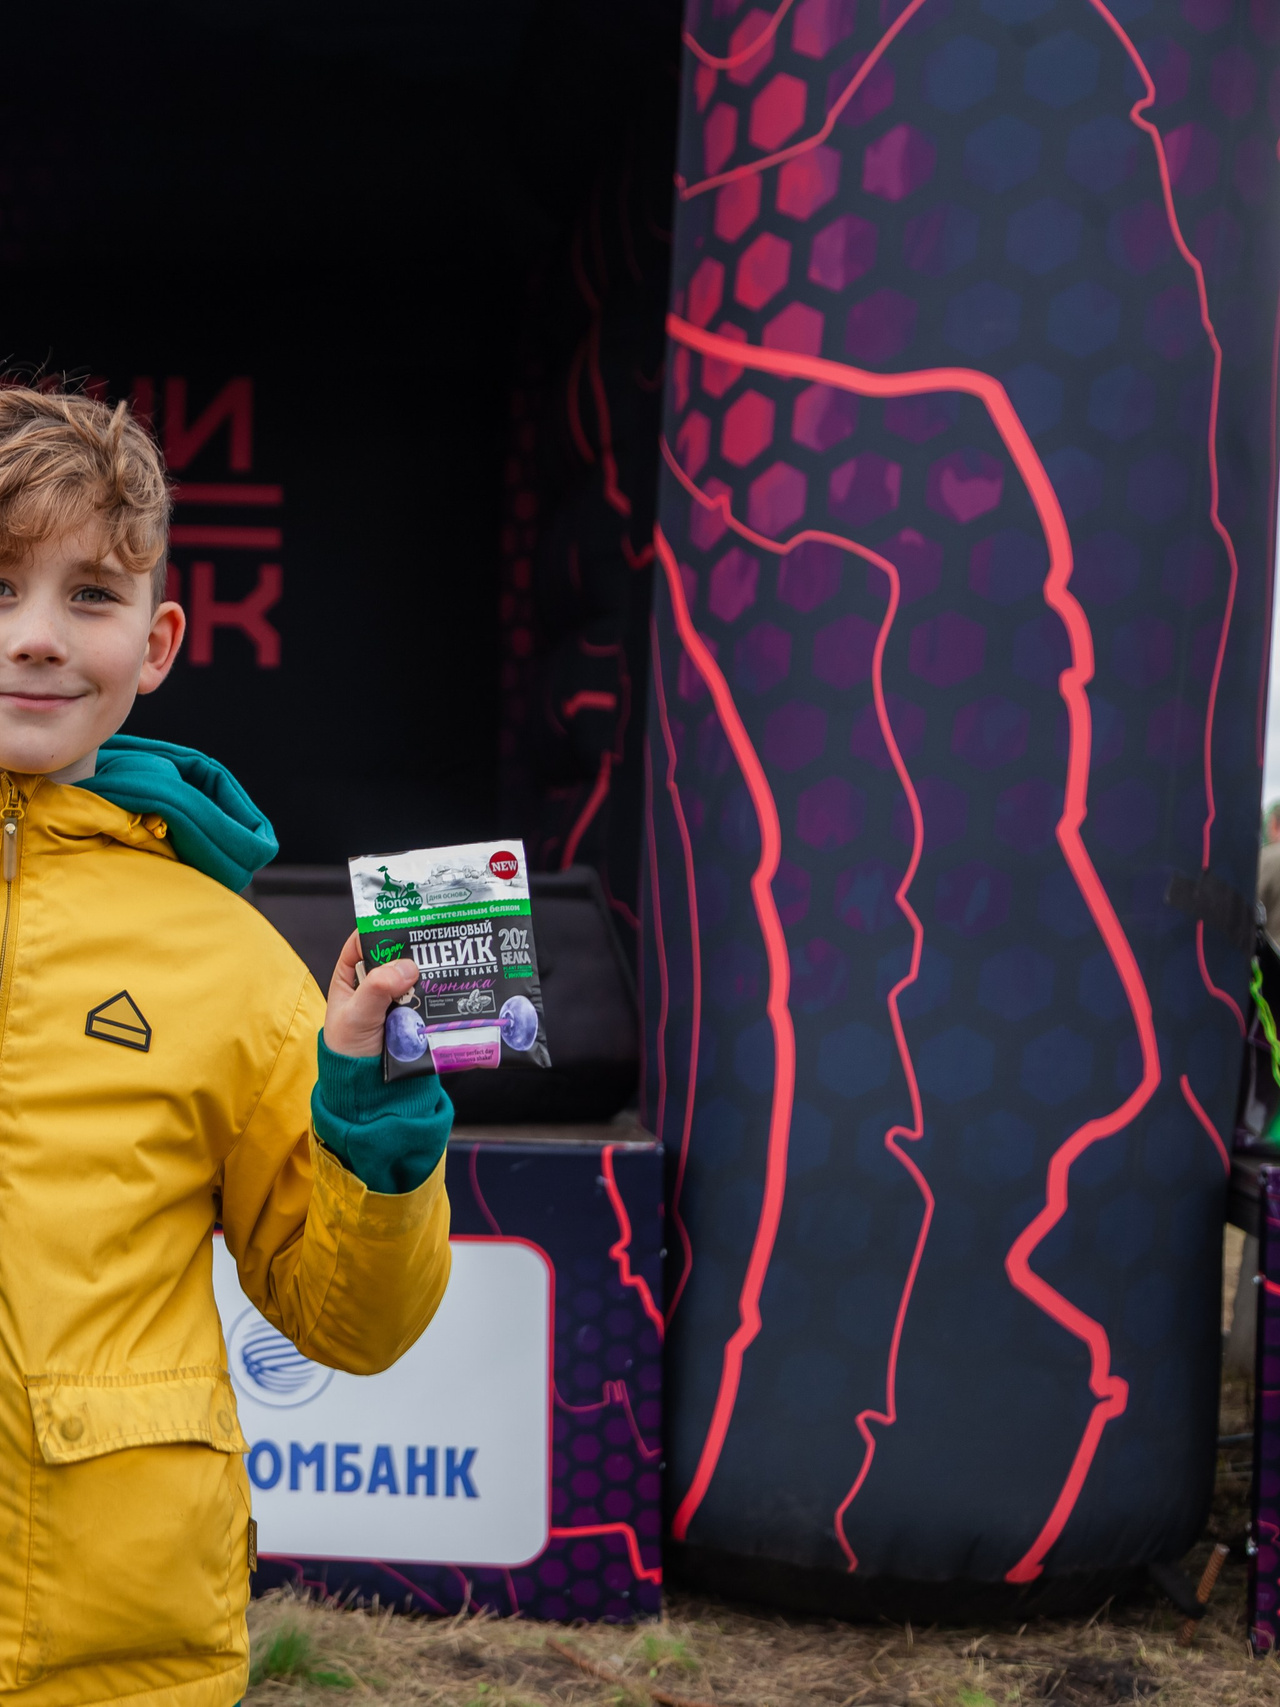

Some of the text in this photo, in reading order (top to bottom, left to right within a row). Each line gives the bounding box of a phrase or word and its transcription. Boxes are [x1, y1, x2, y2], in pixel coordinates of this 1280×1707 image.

[491, 860, 518, 872] NEW
[375, 896, 422, 910] bionova
[443, 891, 467, 899] ОСНОВА
[372, 916, 419, 927] Обогащен
[420, 907, 488, 923] растительным
[408, 919, 493, 943] ПРОТЕИНОВЫЙ
[498, 927, 529, 951] 20%
[370, 941, 406, 963] Vegan
[410, 935, 497, 969] ШЕЙК
[501, 951, 531, 966] БЕЛКА
[421, 965, 499, 980] ROTEIN SHAKE
[420, 978, 496, 998] Черника
